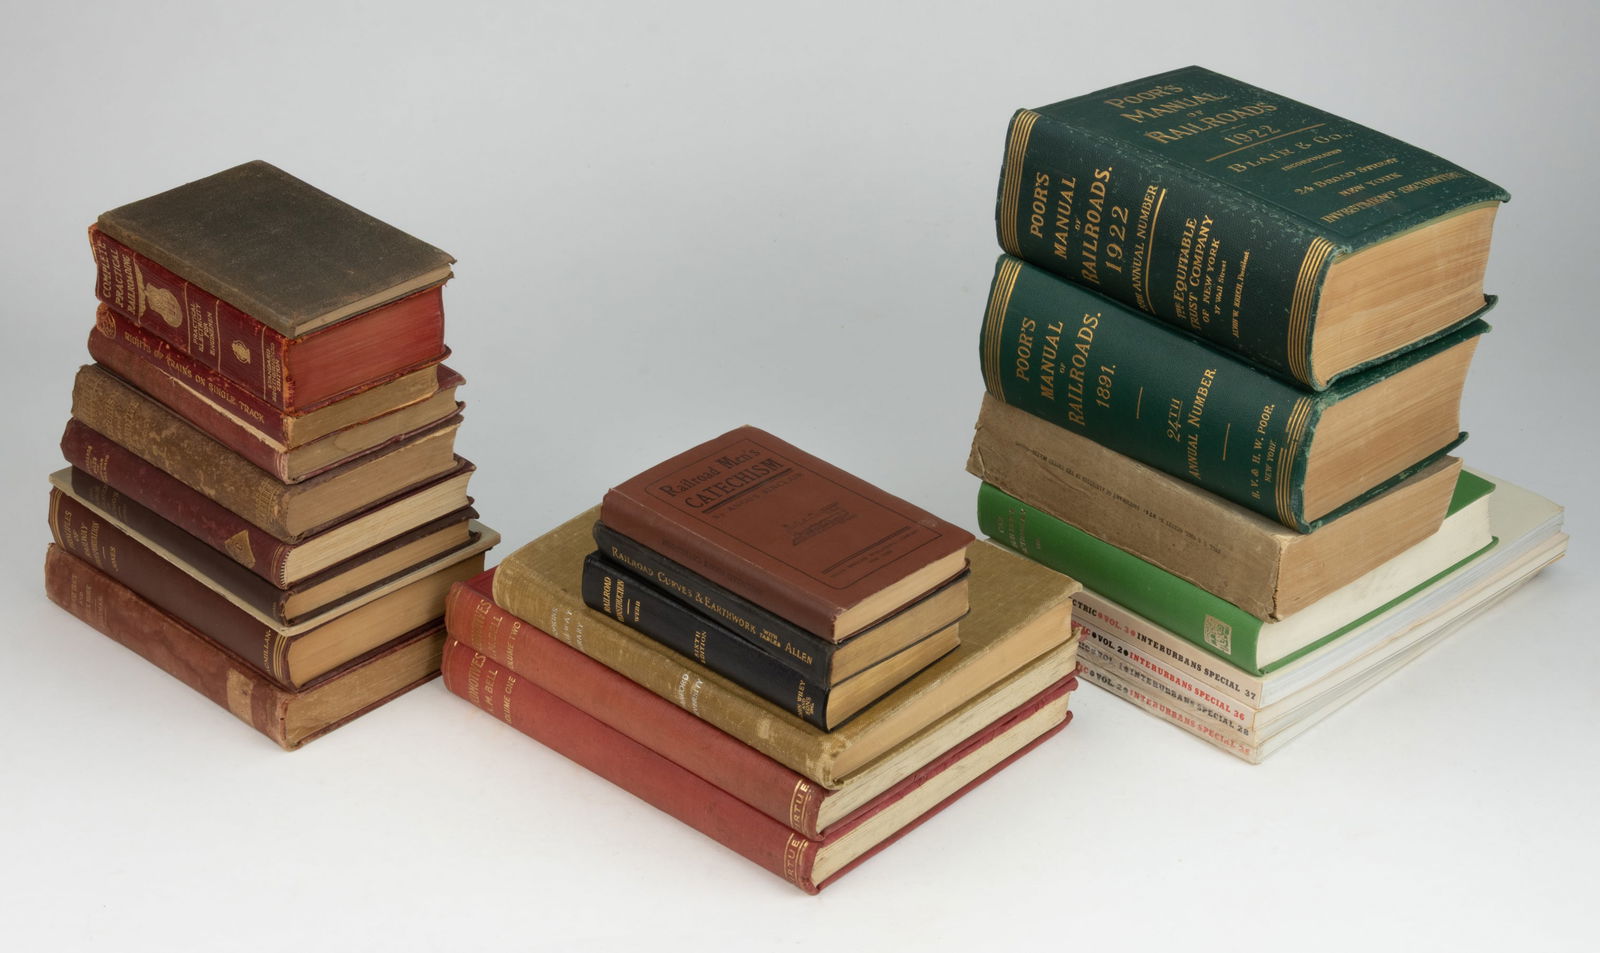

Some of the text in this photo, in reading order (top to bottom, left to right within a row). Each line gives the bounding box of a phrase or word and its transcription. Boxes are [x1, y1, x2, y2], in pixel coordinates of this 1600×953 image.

[1104, 84, 1184, 110] POOR'S
[1119, 92, 1228, 124] MANUAL
[1144, 102, 1278, 144] RAILROADS
[1223, 125, 1281, 146] 1922
[1226, 148, 1295, 174] BLAIR
[1295, 141, 1313, 152] &
[1030, 172, 1049, 238] POOR'S
[1312, 171, 1356, 188] BROAD
[1364, 171, 1405, 187] YORK
[1054, 177, 1076, 261] MANUAL
[1074, 217, 1082, 233] OF
[1082, 166, 1113, 285] RAILROADS.
[1136, 185, 1159, 240] NUMBER
[1320, 190, 1398, 224] INVESTMENT
[1105, 205, 1129, 273] 1922
[1173, 218, 1198, 303] EQUITABLE
[111, 248, 124, 308] PRACTICAL
[1132, 242, 1146, 292] ANNUAL
[1189, 215, 1214, 330] TRUST COMPANY
[1202, 239, 1221, 324] OF NEW YORK
[1218, 260, 1227, 284] Street
[1216, 285, 1224, 303] Wall
[1016, 317, 1036, 382] POOR'S
[1040, 320, 1064, 400] MANUAL
[1068, 312, 1102, 427] RAILROADS.
[166, 356, 193, 378] TRAINS
[239, 402, 265, 424] TRACK
[1096, 363, 1117, 409] 1891.
[1187, 368, 1217, 480] ANNUAL NUMBER.
[1258, 403, 1276, 436] POOR.
[659, 450, 761, 497] Railroad Men's
[684, 457, 784, 509] CATECHISM
[602, 576, 612, 614] RAILROAD
[611, 546, 655, 578] RAILROAD
[657, 571, 694, 599] CURVES
[704, 597, 756, 634] EARTHWORK
[511, 621, 521, 641] TWO
[785, 642, 814, 666] ALLEN
[505, 676, 516, 694] ONE
[1129, 652, 1198, 692] INTERURBANS
[1194, 687, 1232, 713] SPECIAL
[1137, 633, 1202, 673] INTERURBANS
[1203, 668, 1240, 693] SPECIAL
[1243, 689, 1257, 701] 37
[1128, 690, 1196, 730] INTERURBANS
[1197, 724, 1237, 750] SPECIAL
[1129, 667, 1196, 708] INTERURBANS
[1196, 703, 1235, 729] SPECIAL
